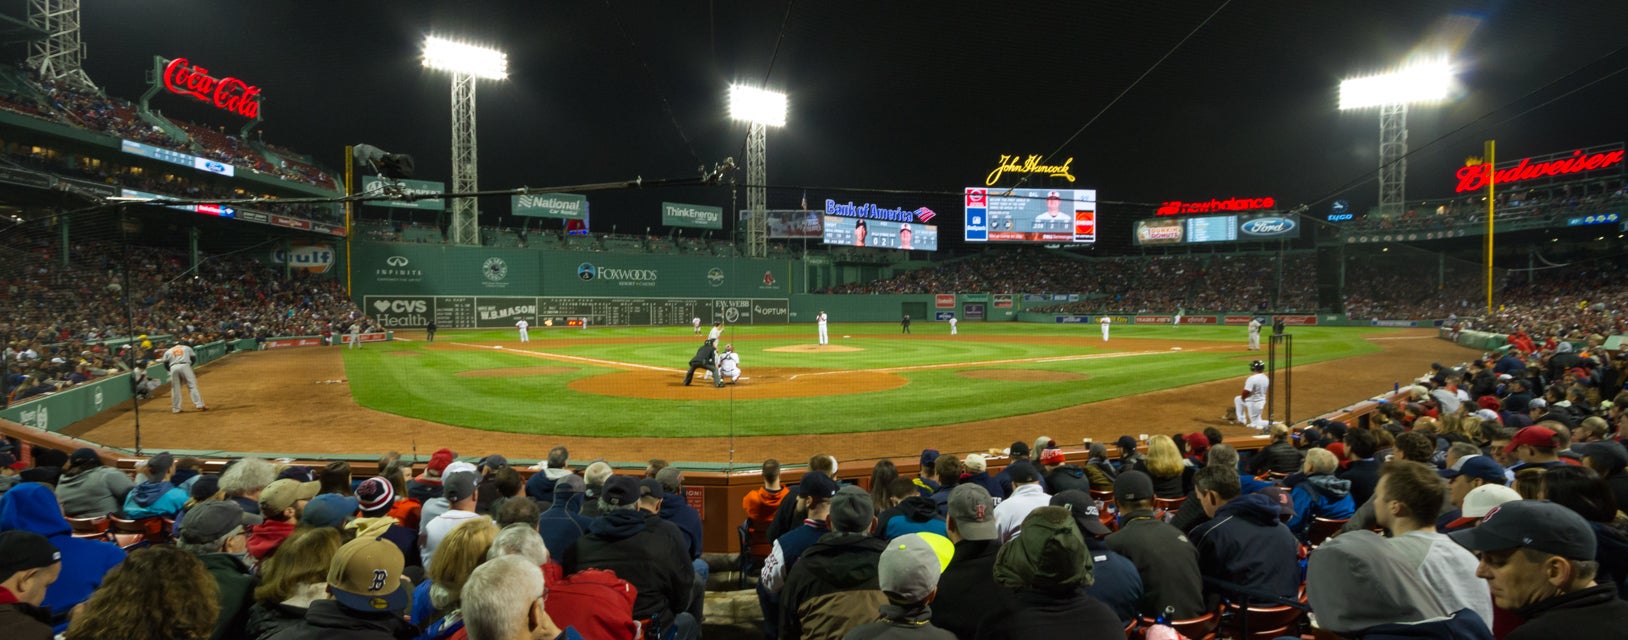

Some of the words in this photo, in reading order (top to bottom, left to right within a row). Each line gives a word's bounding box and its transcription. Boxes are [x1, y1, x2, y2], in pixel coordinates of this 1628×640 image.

[163, 57, 261, 118] Coca-Cola
[985, 154, 1023, 186] John
[1021, 154, 1076, 182] Hancock
[1455, 150, 1625, 193] Budweiser
[532, 197, 580, 210] National
[825, 199, 857, 217] Bank
[857, 203, 869, 218] of
[870, 204, 914, 222] America
[1250, 220, 1284, 232] Ford
[881, 238, 887, 246] 2
[597, 266, 657, 281] FOXWOODS
[391, 300, 427, 313] CVS
[762, 307, 787, 315] OPTUM
[376, 314, 428, 327] Health
[368, 569, 388, 592] B
